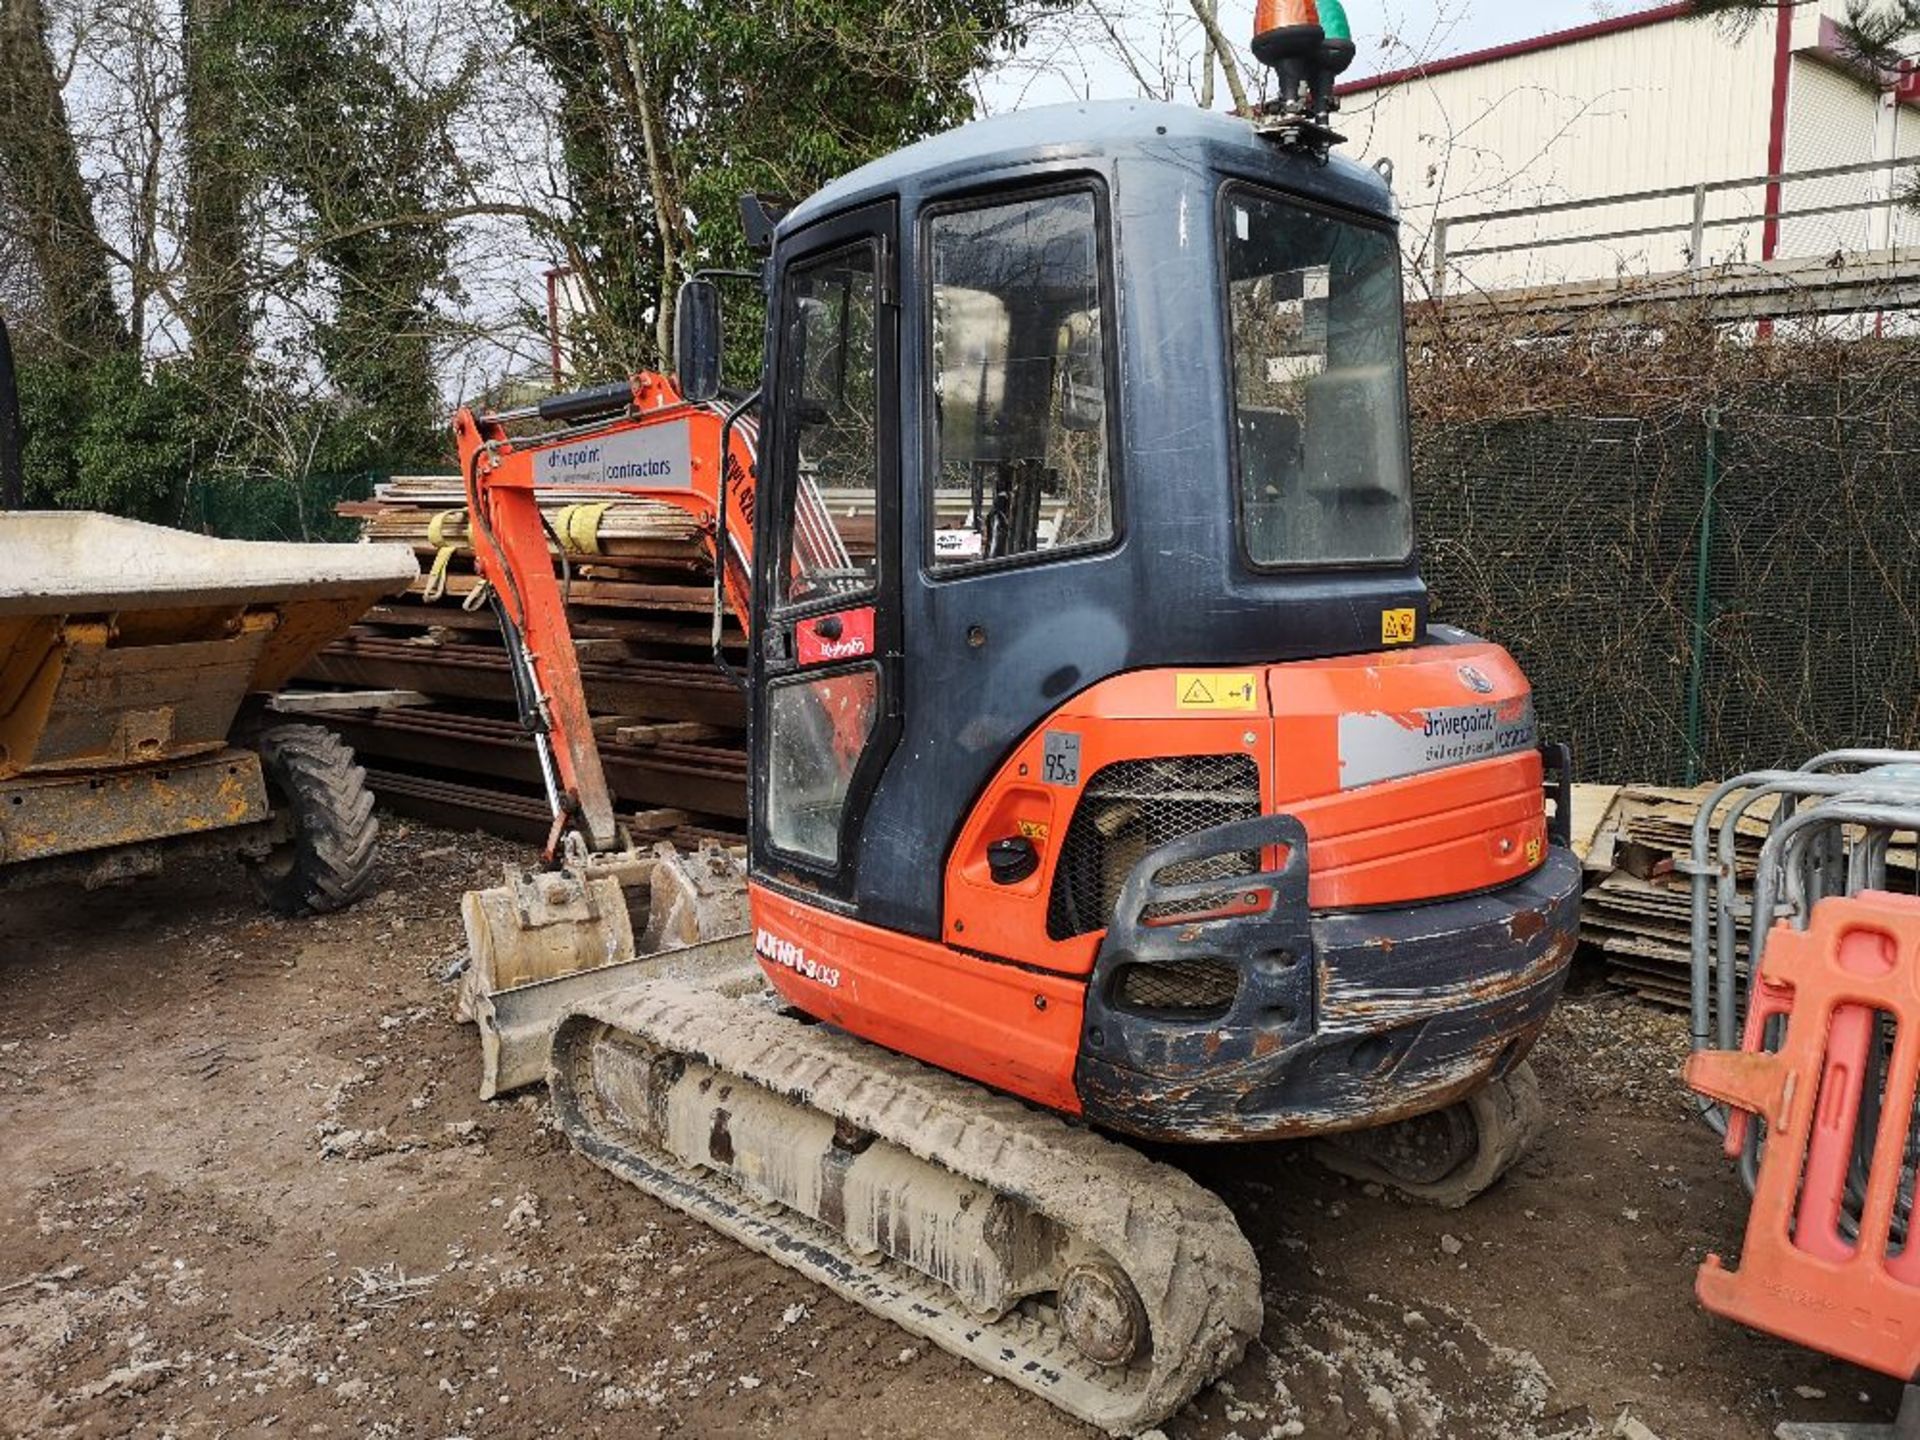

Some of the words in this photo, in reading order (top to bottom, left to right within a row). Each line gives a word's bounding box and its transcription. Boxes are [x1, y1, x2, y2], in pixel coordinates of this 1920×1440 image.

[606, 459, 671, 479] contractors
[1423, 707, 1494, 740] drivepoint
[1045, 754, 1067, 781] 95
